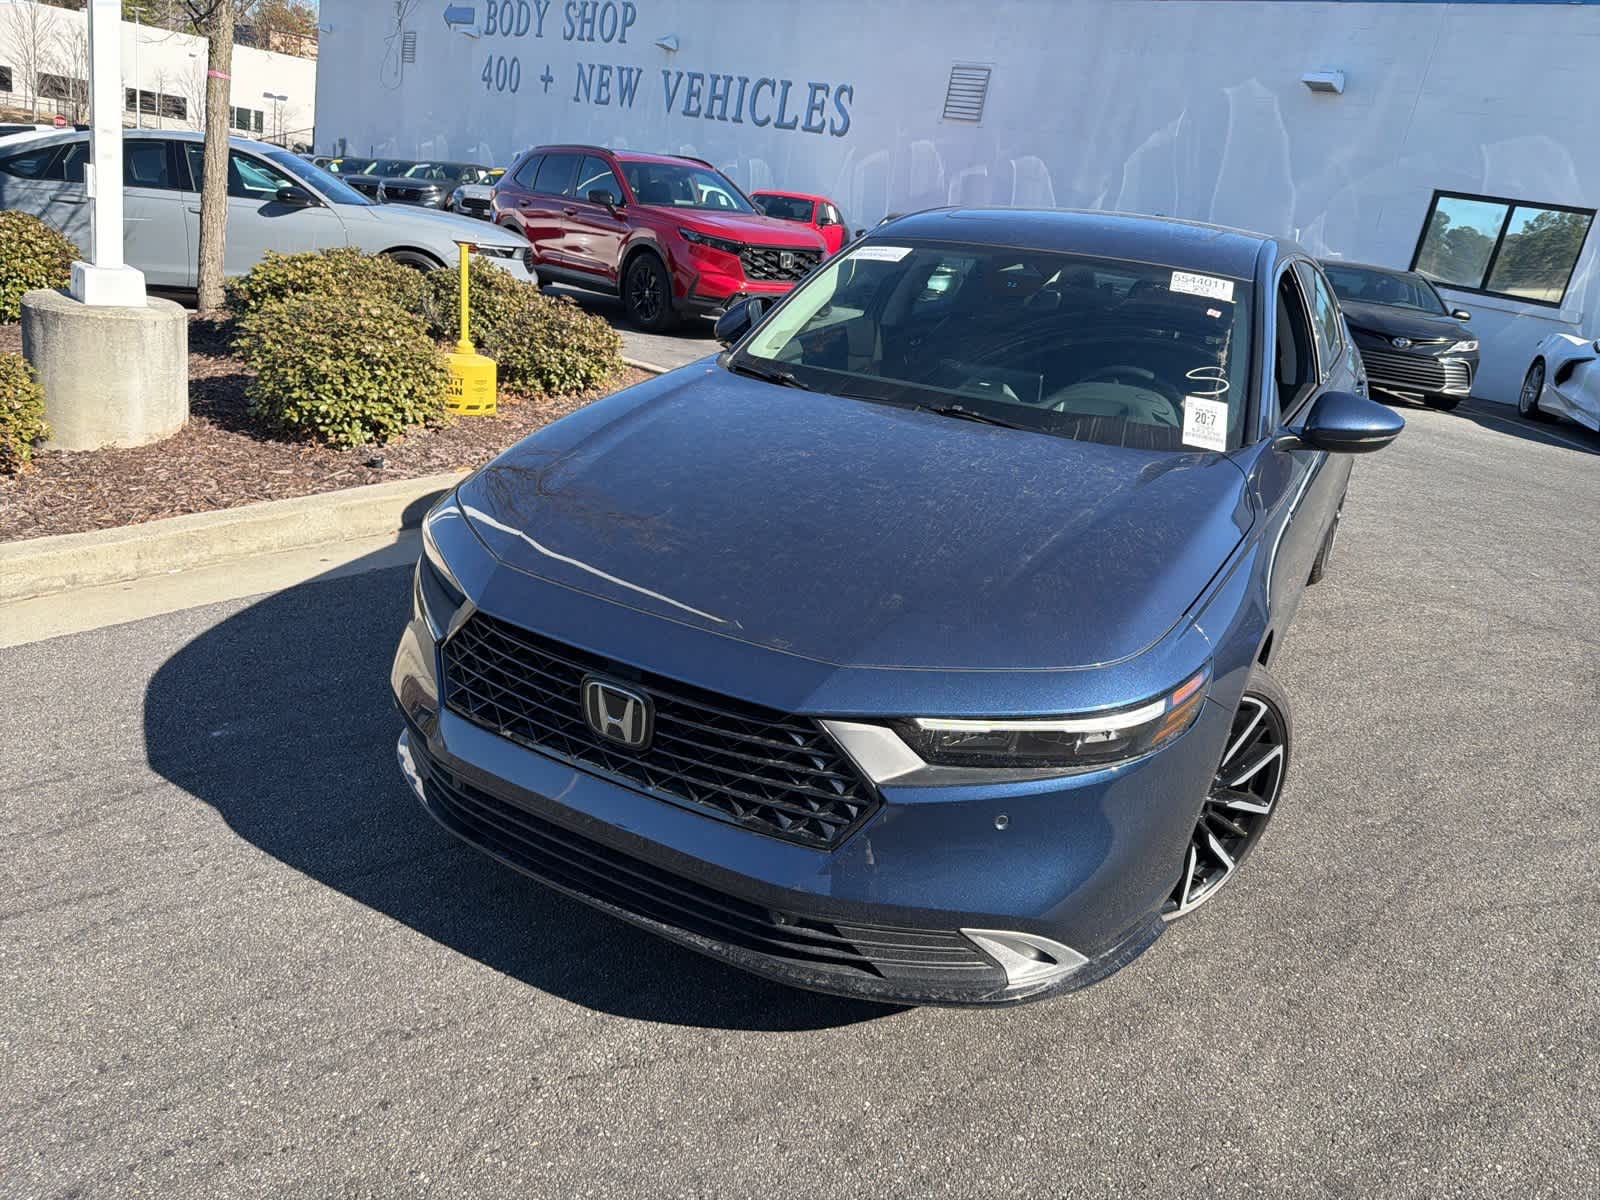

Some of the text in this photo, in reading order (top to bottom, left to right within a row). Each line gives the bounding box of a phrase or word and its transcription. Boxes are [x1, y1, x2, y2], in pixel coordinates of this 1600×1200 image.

[484, 0, 637, 44] BODY SHOP
[481, 54, 854, 138] 400 + NEW VEHICLES
